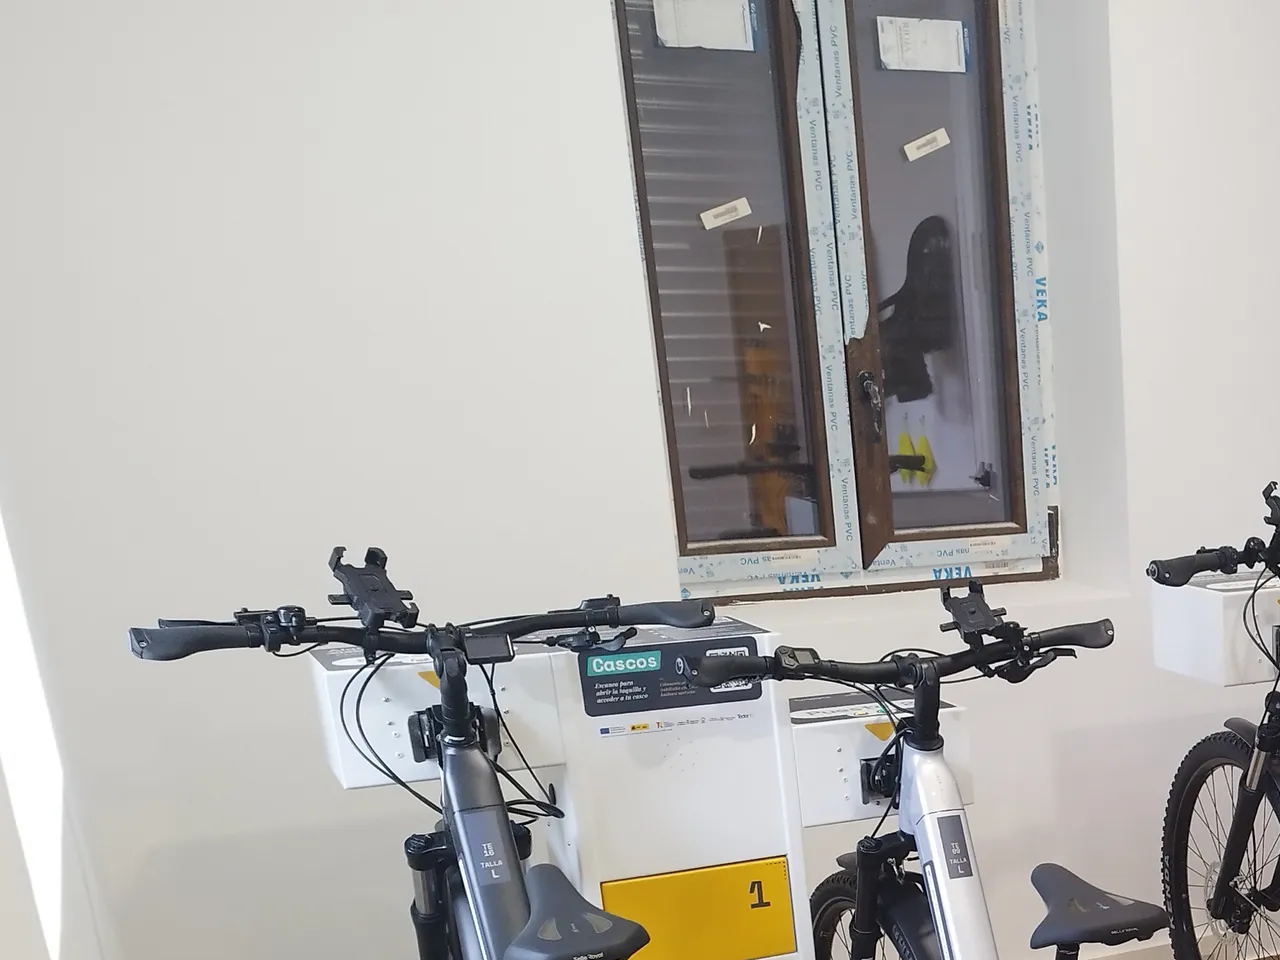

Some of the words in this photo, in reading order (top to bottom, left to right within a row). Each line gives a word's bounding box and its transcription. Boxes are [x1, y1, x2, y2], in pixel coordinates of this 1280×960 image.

[829, 24, 838, 47] PVC
[845, 150, 855, 172] PVC
[814, 170, 823, 191] PVC
[1026, 257, 1034, 277] PVC
[831, 290, 839, 311] PVC
[1035, 276, 1048, 322] VEKA
[829, 411, 839, 432] PVC
[845, 522, 854, 542] PVC
[740, 556, 760, 566] PVC
[936, 549, 954, 558] PVC
[932, 566, 972, 580] VEKA
[593, 656, 658, 673] Cascos
[480, 860, 503, 868] TALLA
[491, 869, 500, 878] L
[957, 865, 965, 873] L
[748, 880, 771, 909] 1
[1164, 855, 1176, 930] KENDA
